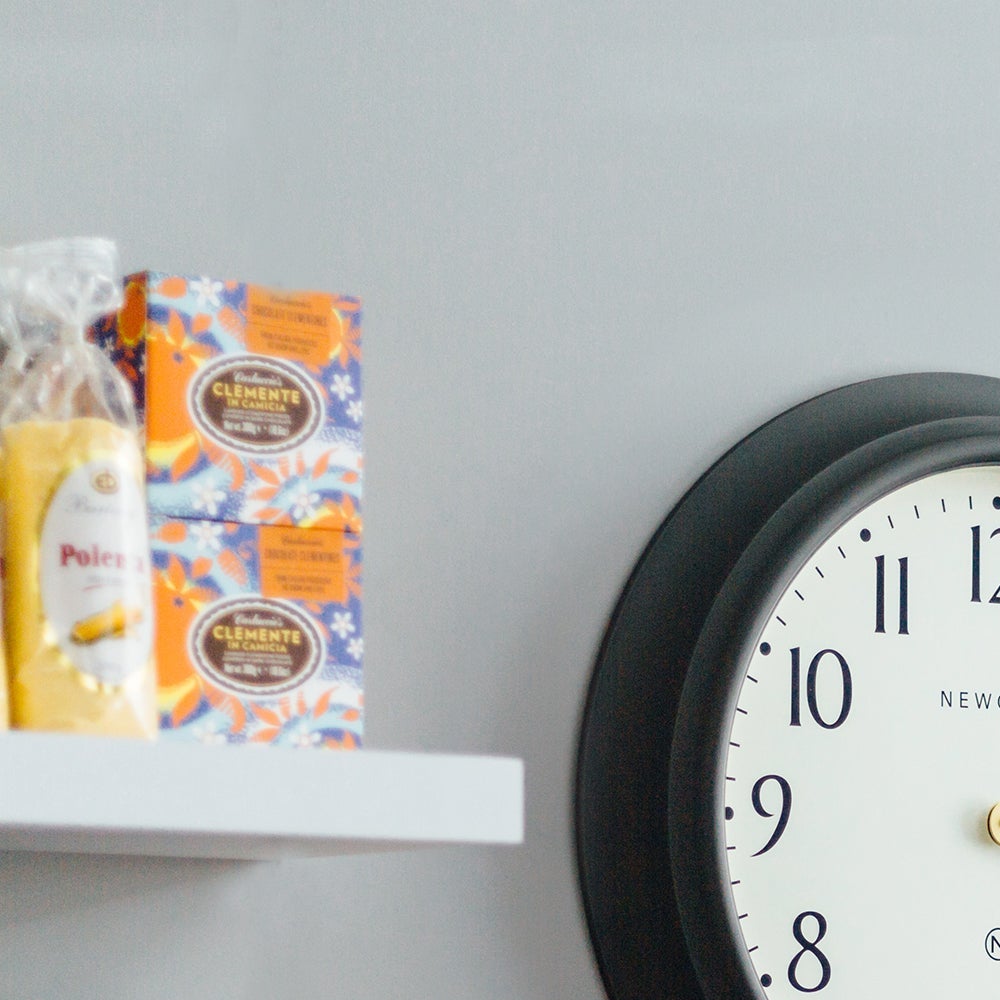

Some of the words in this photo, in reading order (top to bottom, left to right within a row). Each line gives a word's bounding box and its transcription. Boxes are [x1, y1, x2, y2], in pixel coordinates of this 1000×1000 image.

[212, 381, 300, 404] CLEMENTE
[227, 398, 239, 407] IN
[241, 399, 286, 412] CAMICIA
[874, 554, 910, 635] 11
[212, 625, 301, 645] CLEMENTE
[227, 641, 240, 649] IN
[789, 646, 853, 730] 10
[750, 774, 793, 857] 9
[787, 910, 832, 993] 8
